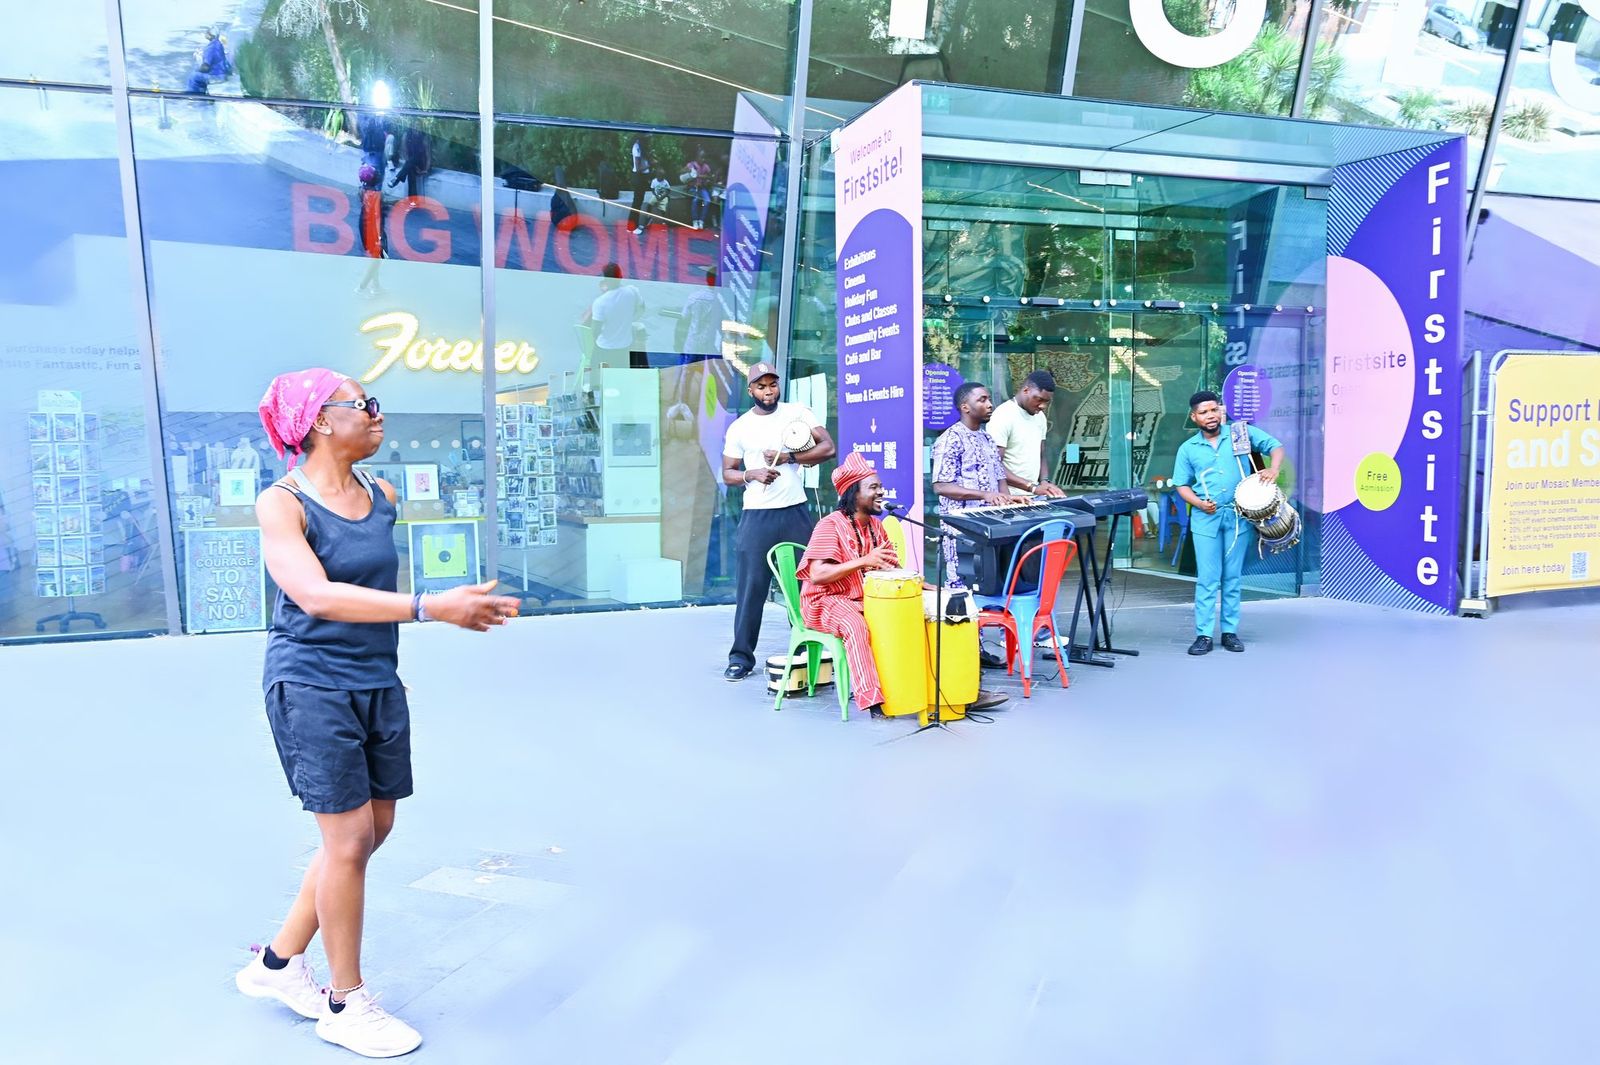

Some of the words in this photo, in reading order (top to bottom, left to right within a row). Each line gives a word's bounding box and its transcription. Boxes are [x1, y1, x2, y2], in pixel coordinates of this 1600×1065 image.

[851, 136, 882, 165] Welcome
[883, 130, 892, 144] to
[843, 146, 903, 205] Firstsite!
[290, 182, 453, 263] BIG
[844, 249, 877, 271] Exhibitions
[844, 273, 866, 290] Cinema
[844, 292, 866, 309] Holiday
[866, 289, 878, 302] Fun
[844, 314, 860, 328] Clubs
[860, 308, 873, 323] and
[873, 303, 898, 319] Classes
[844, 329, 878, 347] Community
[877, 322, 900, 339] Events
[70, 344, 105, 356] today
[858, 349, 870, 363] and
[870, 348, 882, 361] Bar
[106, 360, 130, 370] Fun
[1333, 350, 1407, 374] Firstsite
[844, 373, 860, 386] Shop
[1416, 161, 1451, 587] Firstsite
[844, 391, 863, 404] Venue
[868, 387, 890, 401] Events
[890, 385, 905, 399] Hire
[1508, 398, 1591, 427] Support
[852, 442, 866, 453] Scan
[871, 441, 882, 453] find
[1506, 430, 1571, 469] and
[1367, 470, 1388, 481] Free
[1360, 484, 1394, 492] Admission
[1505, 481, 1523, 491] Join
[1525, 481, 1539, 490] our
[1541, 479, 1569, 489] Mosaic
[204, 540, 246, 556] THE
[195, 558, 255, 568] COURAGE
[1501, 564, 1521, 576] Join
[1521, 564, 1541, 575] here
[1542, 563, 1566, 574] today
[211, 568, 240, 585] TO
[206, 586, 246, 603] SAY
[208, 603, 245, 620] NO!
